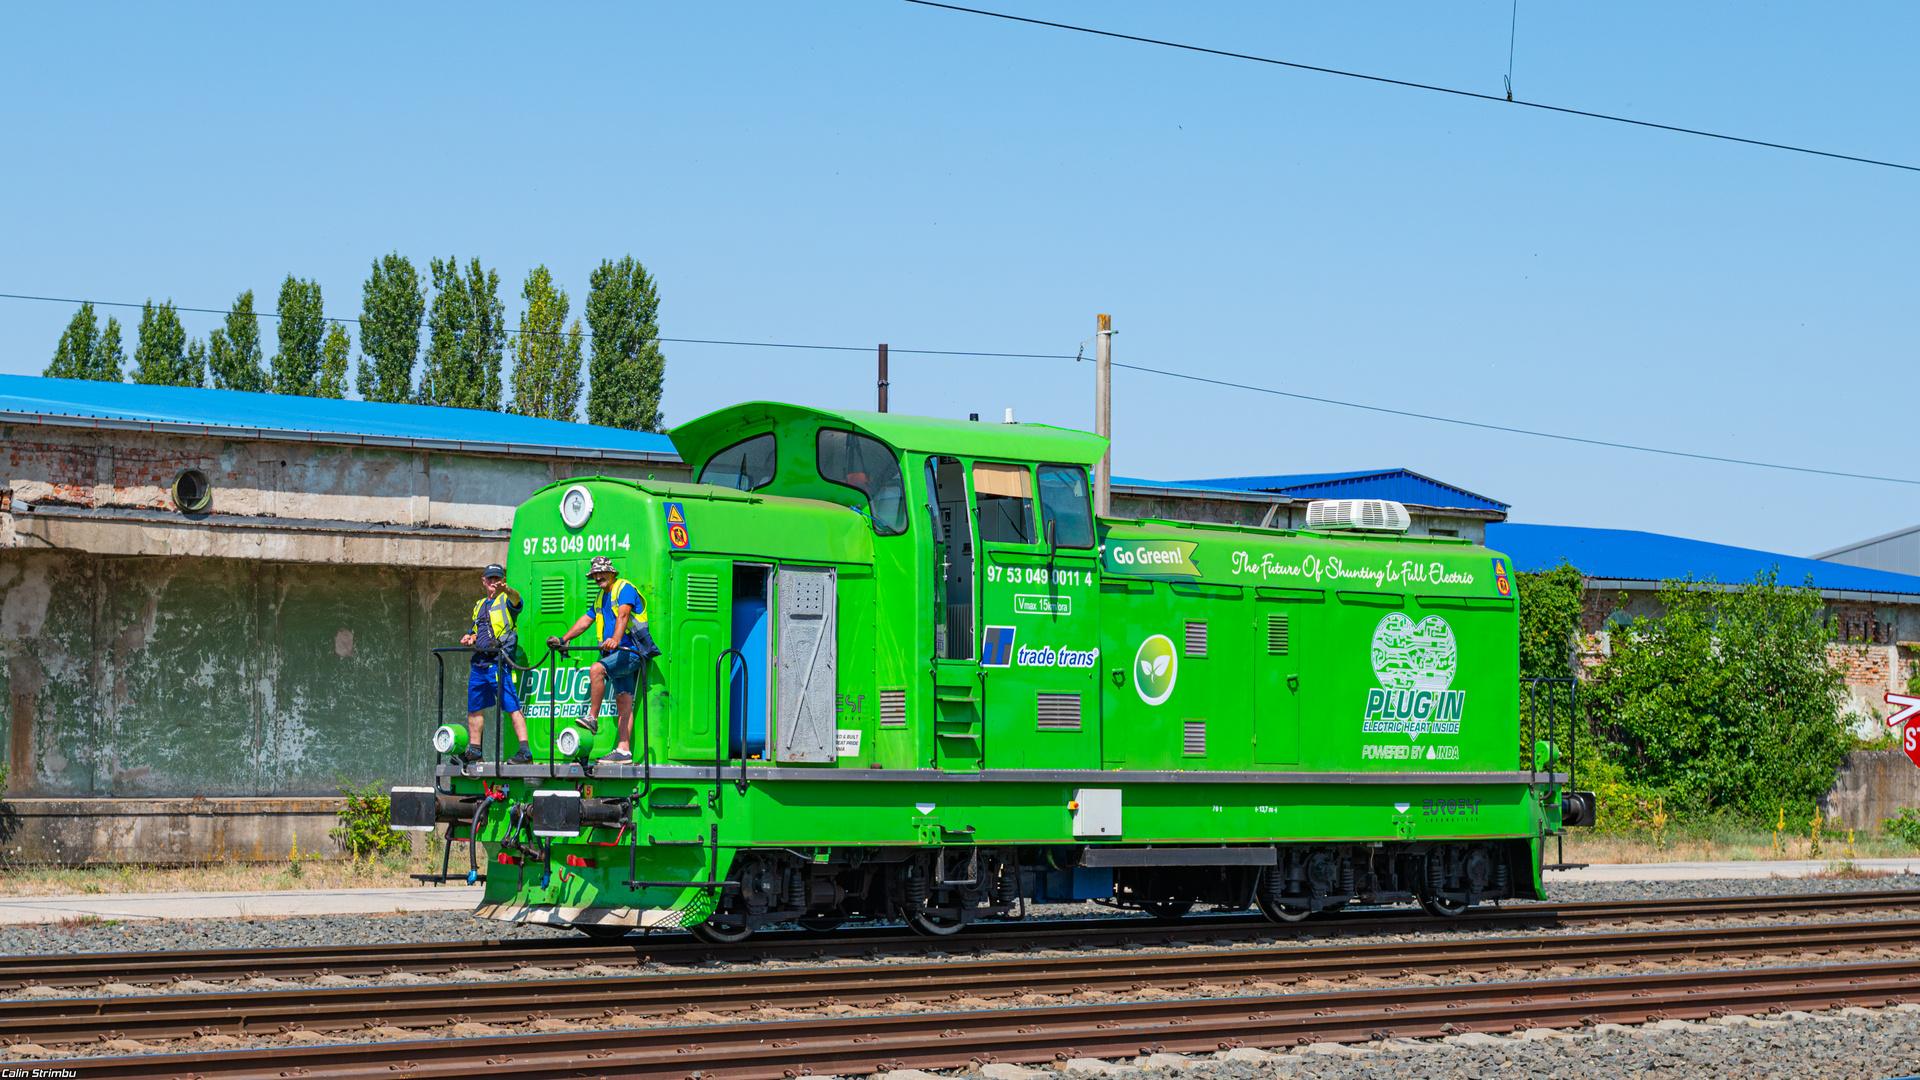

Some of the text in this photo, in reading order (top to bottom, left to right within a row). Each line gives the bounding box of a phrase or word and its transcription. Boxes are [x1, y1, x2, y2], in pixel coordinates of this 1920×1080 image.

[523, 533, 630, 555] 97 53 049 0011-4
[1113, 546, 1183, 565] Go Green!
[987, 565, 1092, 587] 97 53 049 0011 4
[1231, 551, 1474, 588] The Future Of Shunting Is Full Electric
[1018, 597, 1037, 610] Vmax
[1018, 644, 1056, 666] trade
[518, 666, 592, 703] PLUG
[561, 703, 592, 718] HEAR
[1364, 688, 1465, 721] PLUG IN
[1362, 720, 1460, 734] ELECTRIC HEART INSIDE
[1362, 745, 1410, 760] POWERED
[1410, 745, 1426, 760] BY
